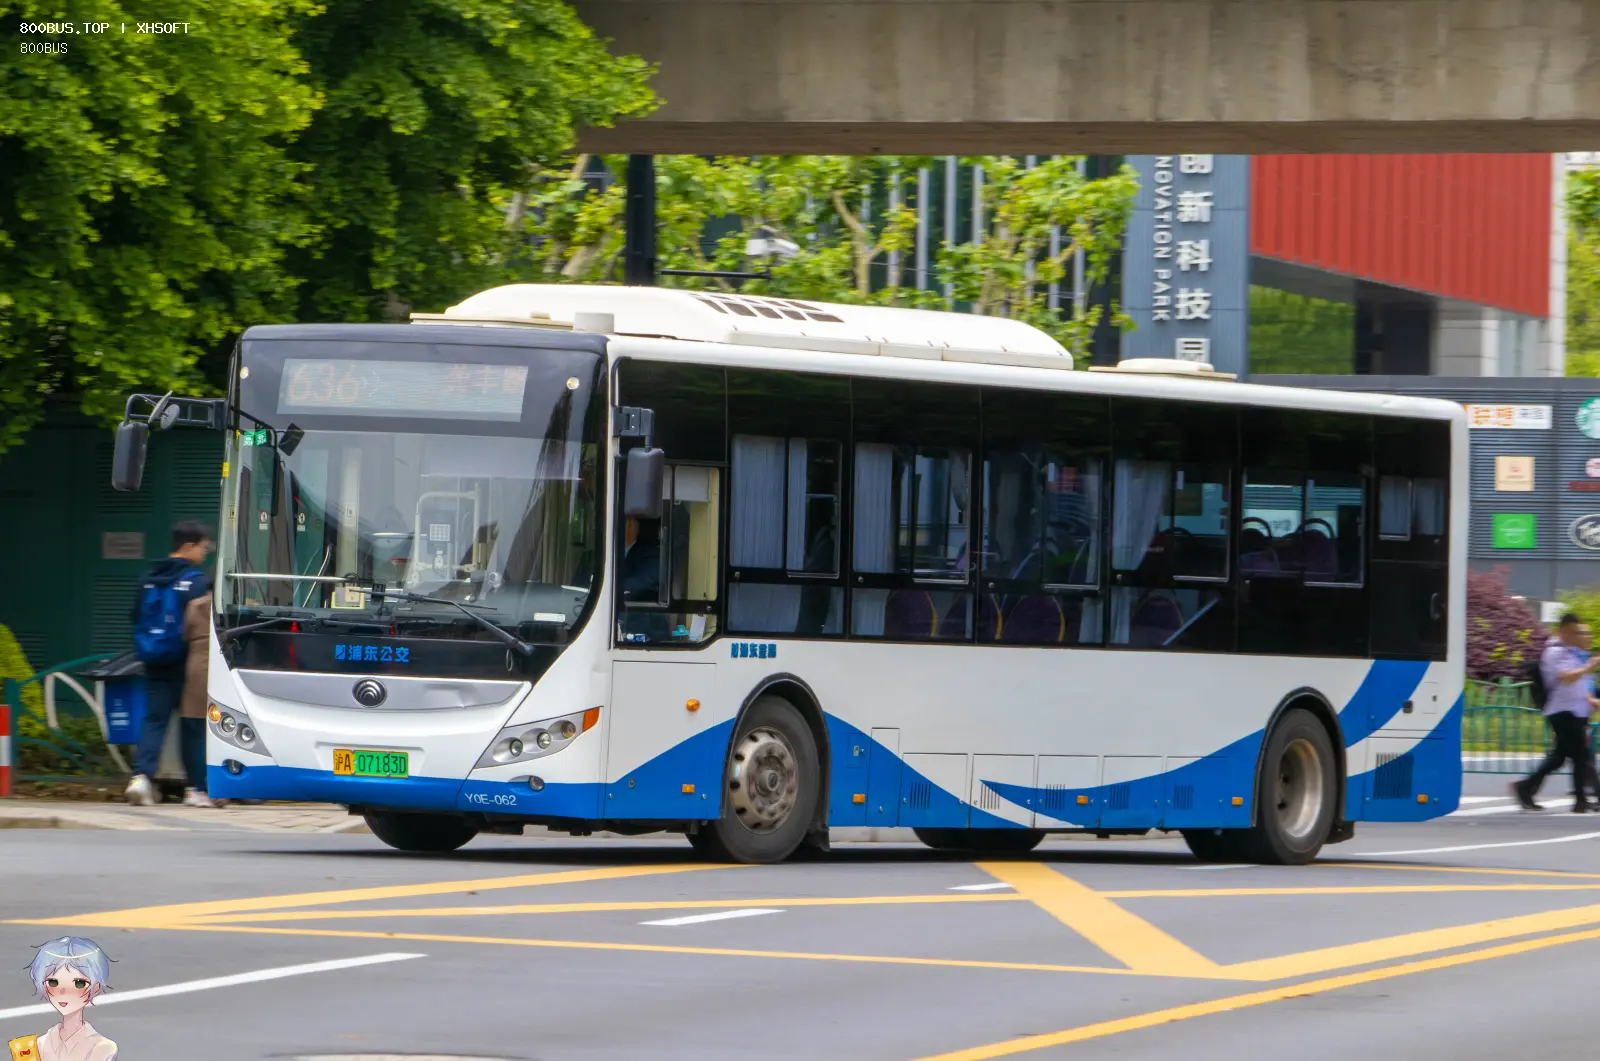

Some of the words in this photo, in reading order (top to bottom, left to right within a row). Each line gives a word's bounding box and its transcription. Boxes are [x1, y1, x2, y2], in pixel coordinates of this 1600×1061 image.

[1153, 156, 1173, 259] NOVATION
[1152, 268, 1172, 321] PARK
[287, 363, 363, 402] 636
[348, 644, 410, 663] 浦东公交
